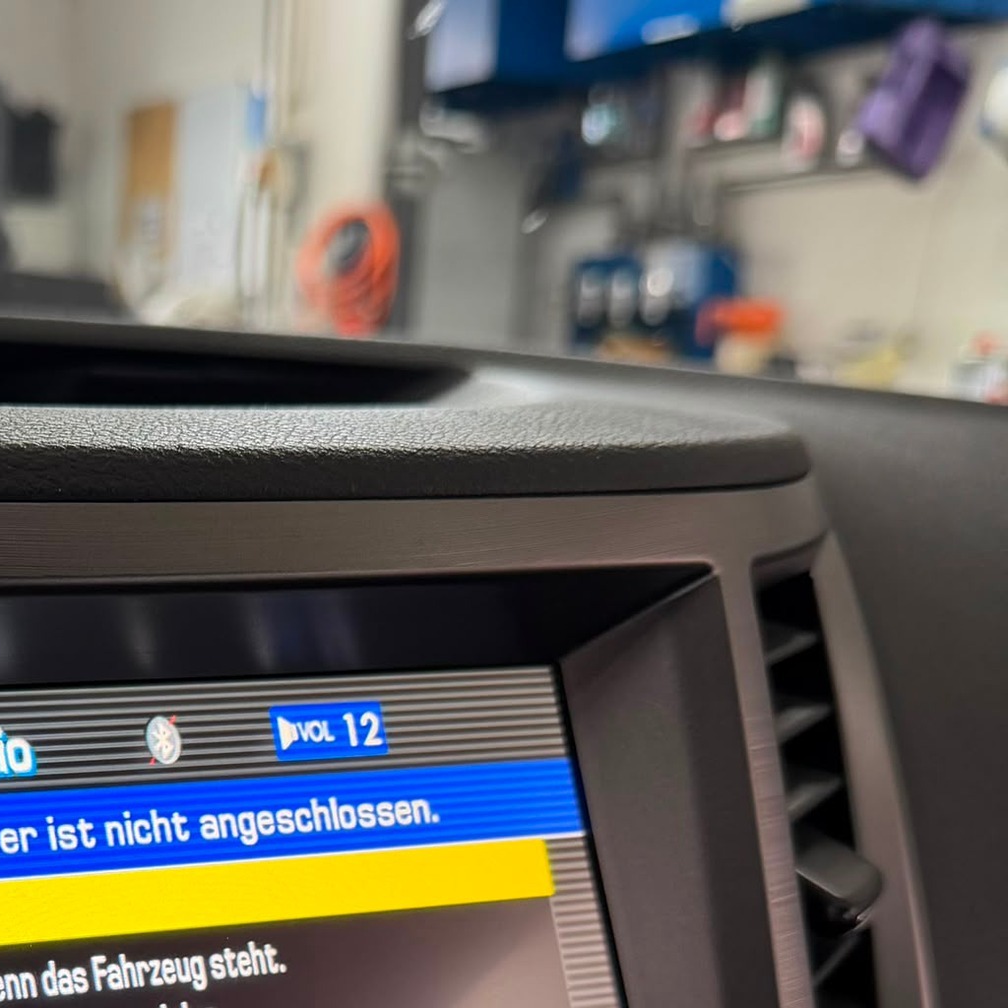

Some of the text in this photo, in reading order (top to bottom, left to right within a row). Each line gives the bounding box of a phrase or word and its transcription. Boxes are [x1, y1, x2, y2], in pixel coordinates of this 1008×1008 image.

[298, 711, 383, 748] VOL 12
[47, 815, 95, 849] ist
[106, 809, 190, 847] nicht
[199, 796, 440, 846] angeschlossen.
[41, 959, 90, 997] das
[91, 950, 206, 991] Fahrzeug
[210, 940, 288, 982] steht.
